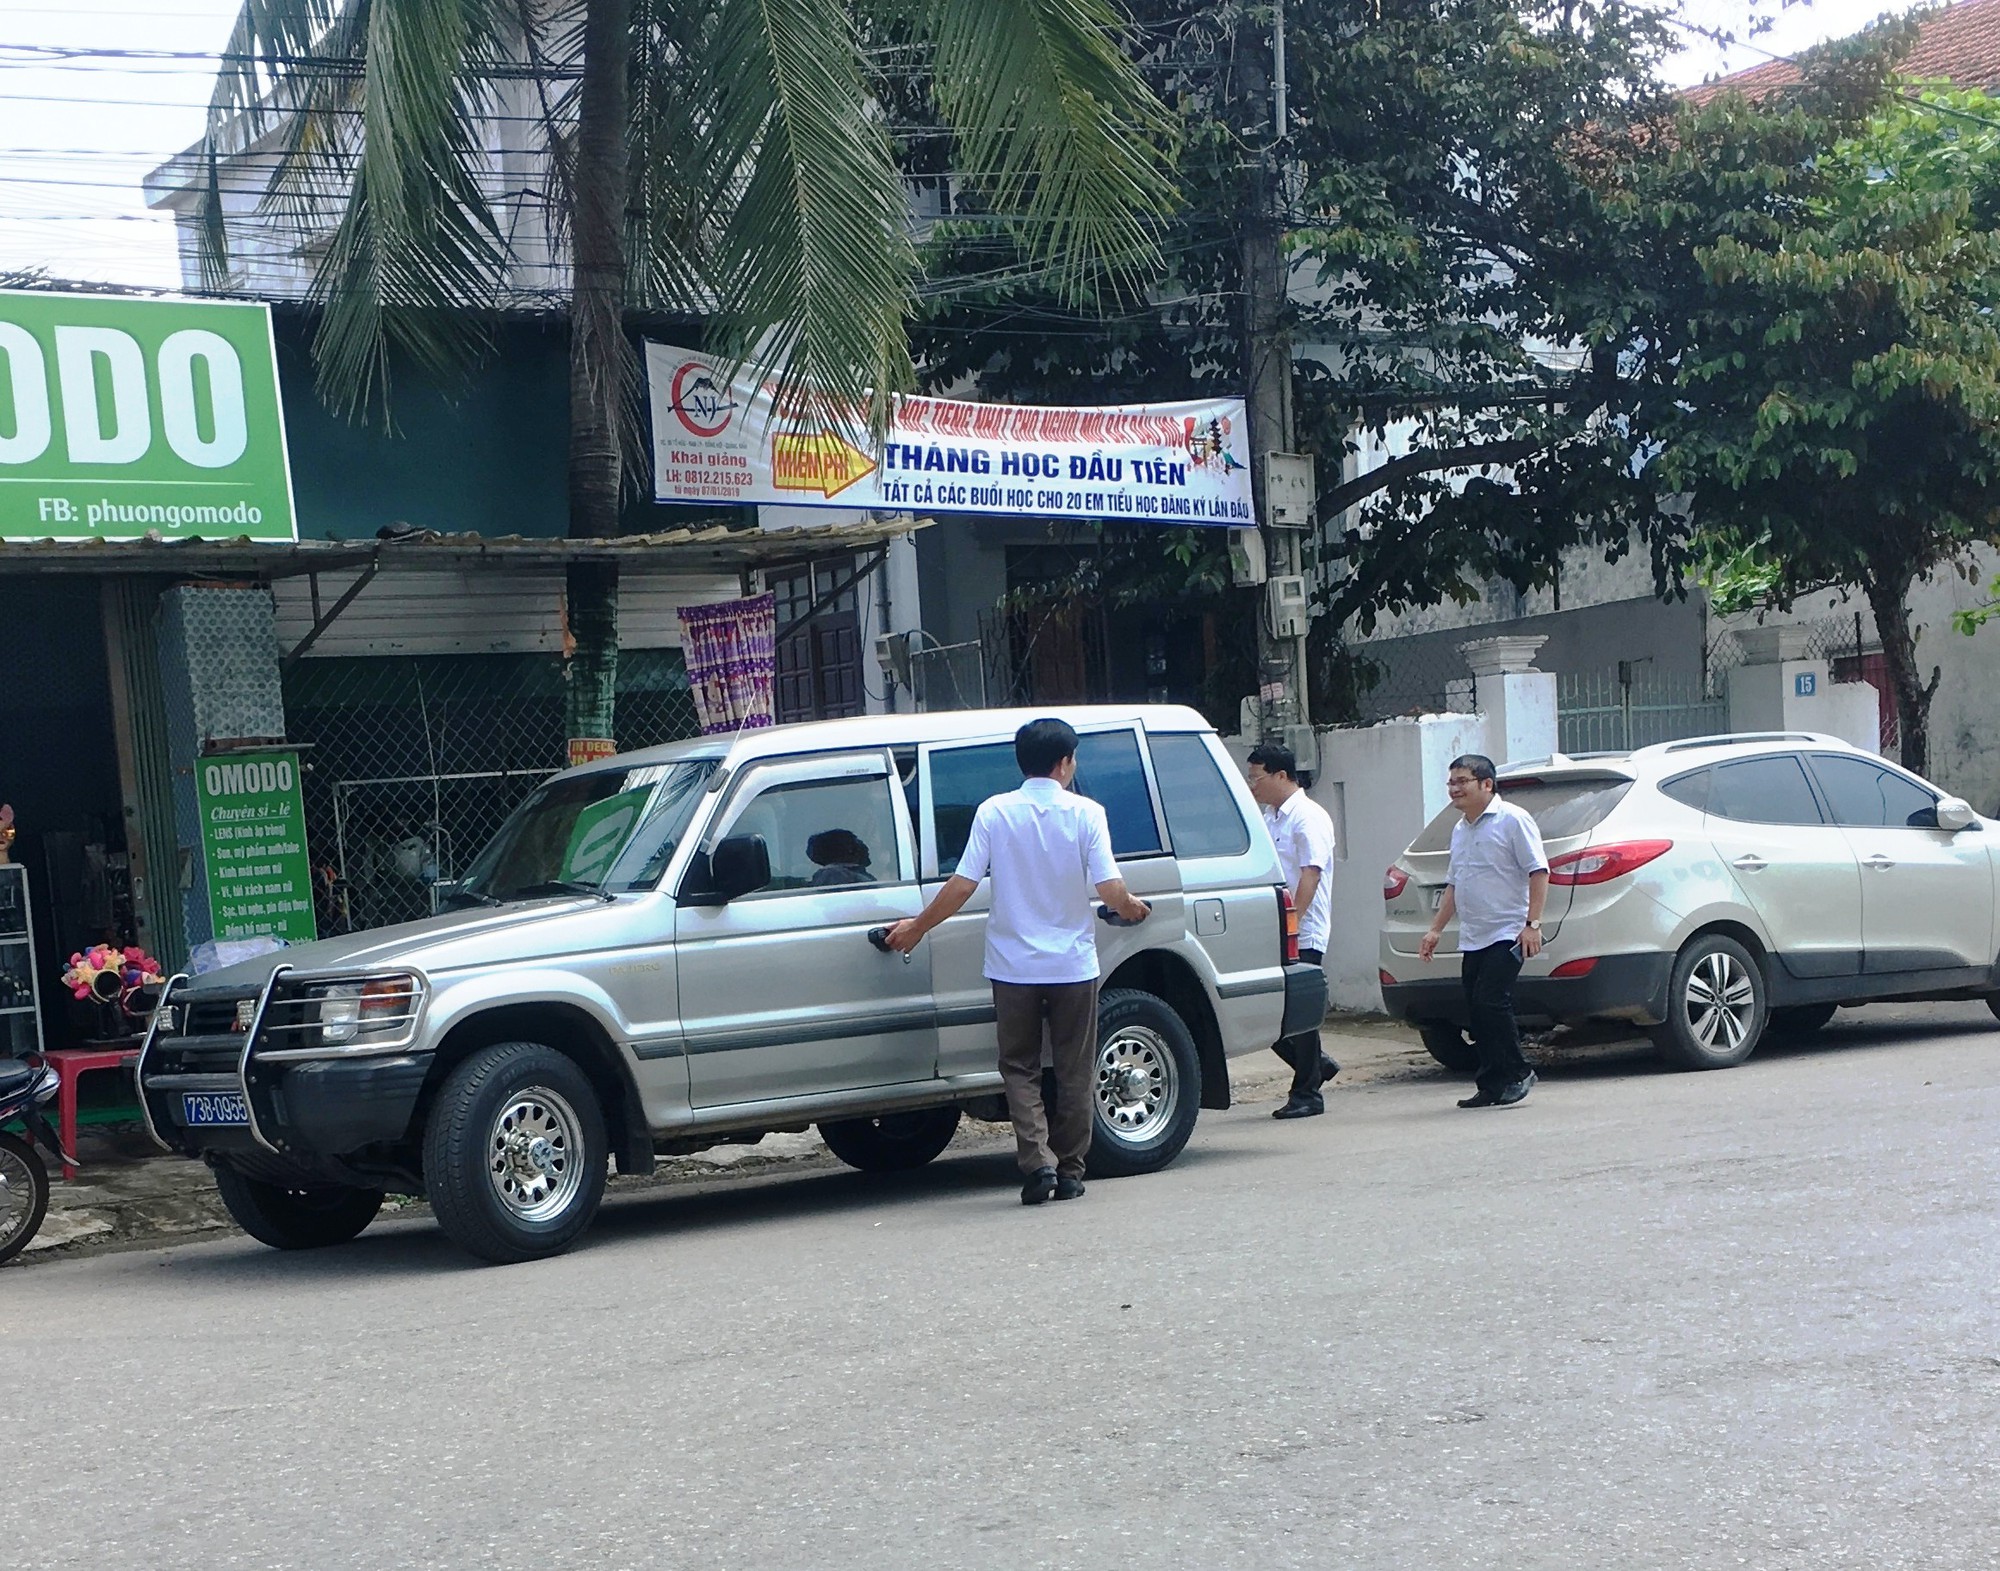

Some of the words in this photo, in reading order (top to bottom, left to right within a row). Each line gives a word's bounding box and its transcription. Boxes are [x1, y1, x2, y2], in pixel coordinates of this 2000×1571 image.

[1010, 409, 1039, 442] CHO
[671, 450, 703, 465] Khai
[708, 452, 747, 468] giảng
[884, 442, 990, 474] THÁNG
[1001, 451, 1060, 482] HỌC
[1069, 449, 1123, 481] ĐẦU
[1130, 457, 1186, 486] TIÊN
[666, 469, 682, 483] LH:
[684, 470, 753, 486] 0812.215.623
[883, 476, 909, 502] TẤT
[914, 478, 933, 504] CẢ
[938, 481, 966, 505] CÁC
[971, 480, 1003, 507] BUỔI
[1007, 489, 1033, 511] HỌC
[1037, 491, 1063, 509] CHO
[1067, 492, 1081, 510] 20
[1085, 491, 1104, 511] EM
[1107, 488, 1132, 512] TIỂU
[1136, 495, 1158, 517] HỌC
[1193, 495, 1206, 516] KÝ
[38, 498, 79, 522] FB:
[87, 499, 262, 529] phuongomodo
[1800, 676, 1812, 693] 15
[572, 741, 584, 752] IN
[205, 761, 292, 796] OMODO
[211, 804, 256, 822] Chuyên
[214, 827, 234, 840] LENS
